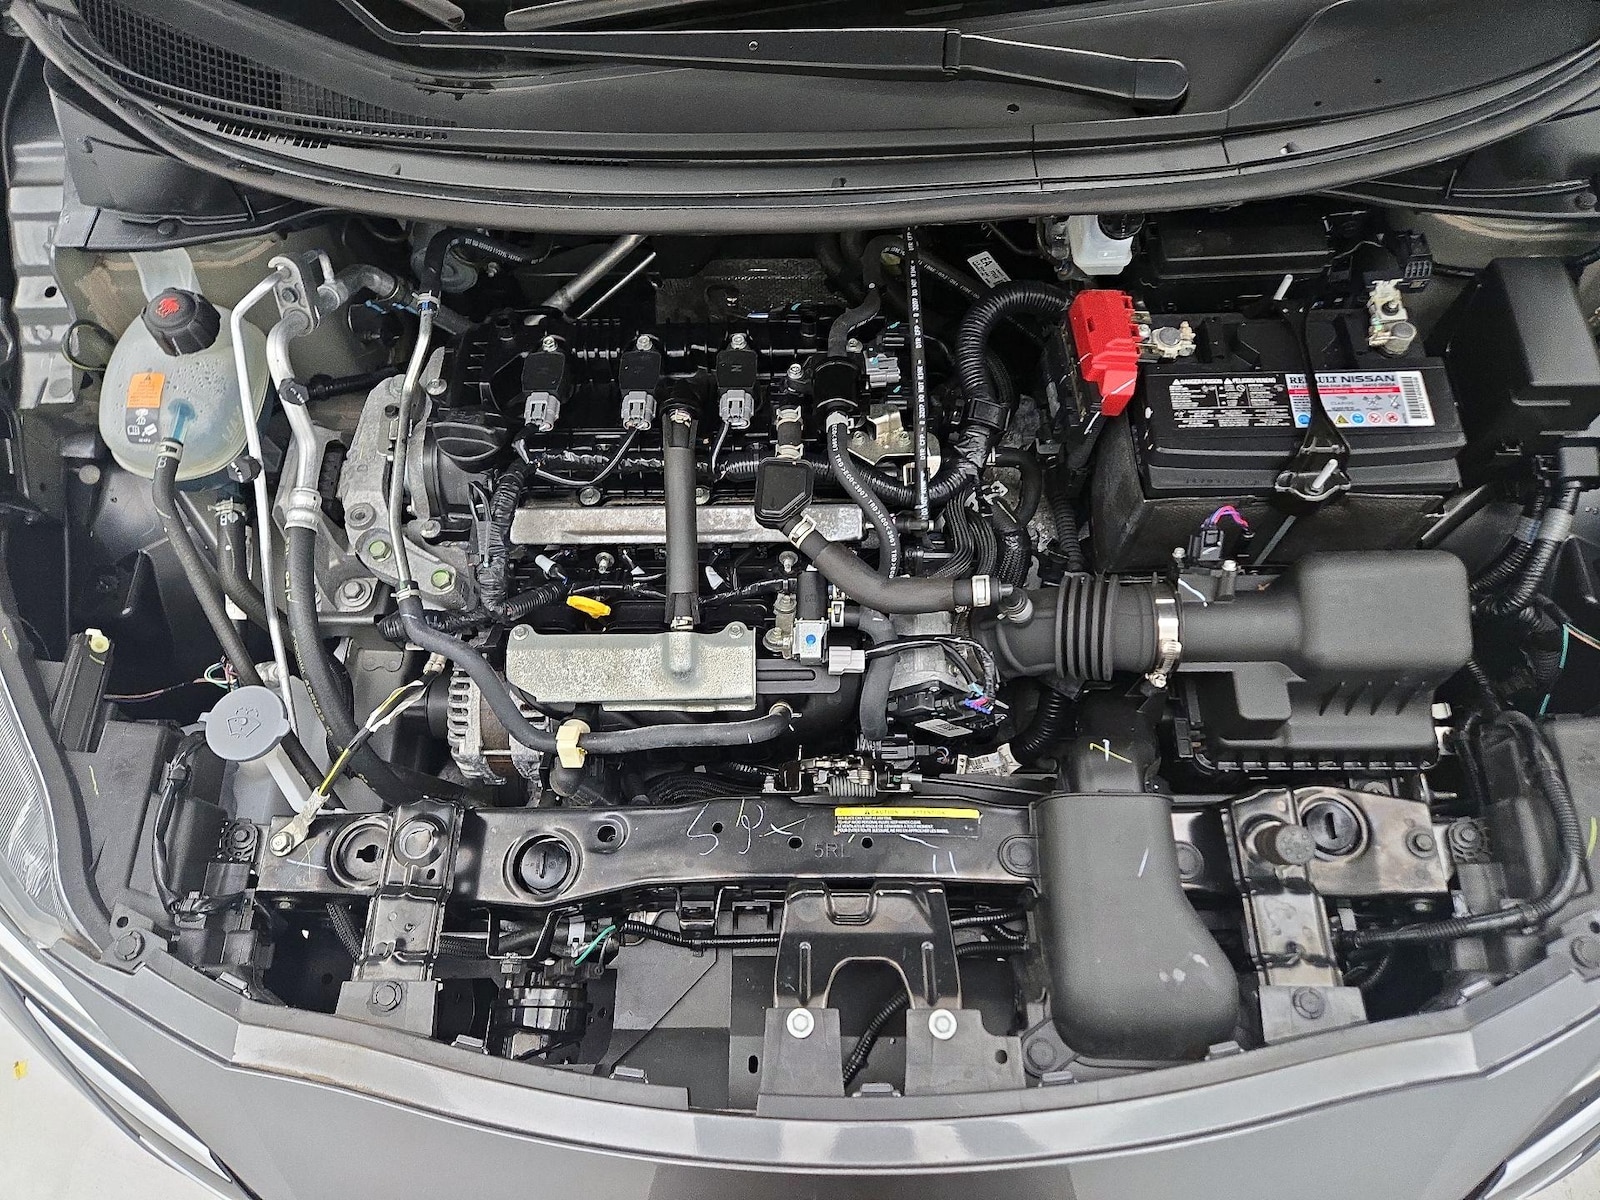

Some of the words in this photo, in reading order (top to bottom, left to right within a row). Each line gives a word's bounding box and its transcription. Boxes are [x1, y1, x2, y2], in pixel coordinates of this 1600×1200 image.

[1289, 376, 1337, 384] REULT
[1341, 374, 1394, 383] NISSAN
[918, 394, 925, 402] DO
